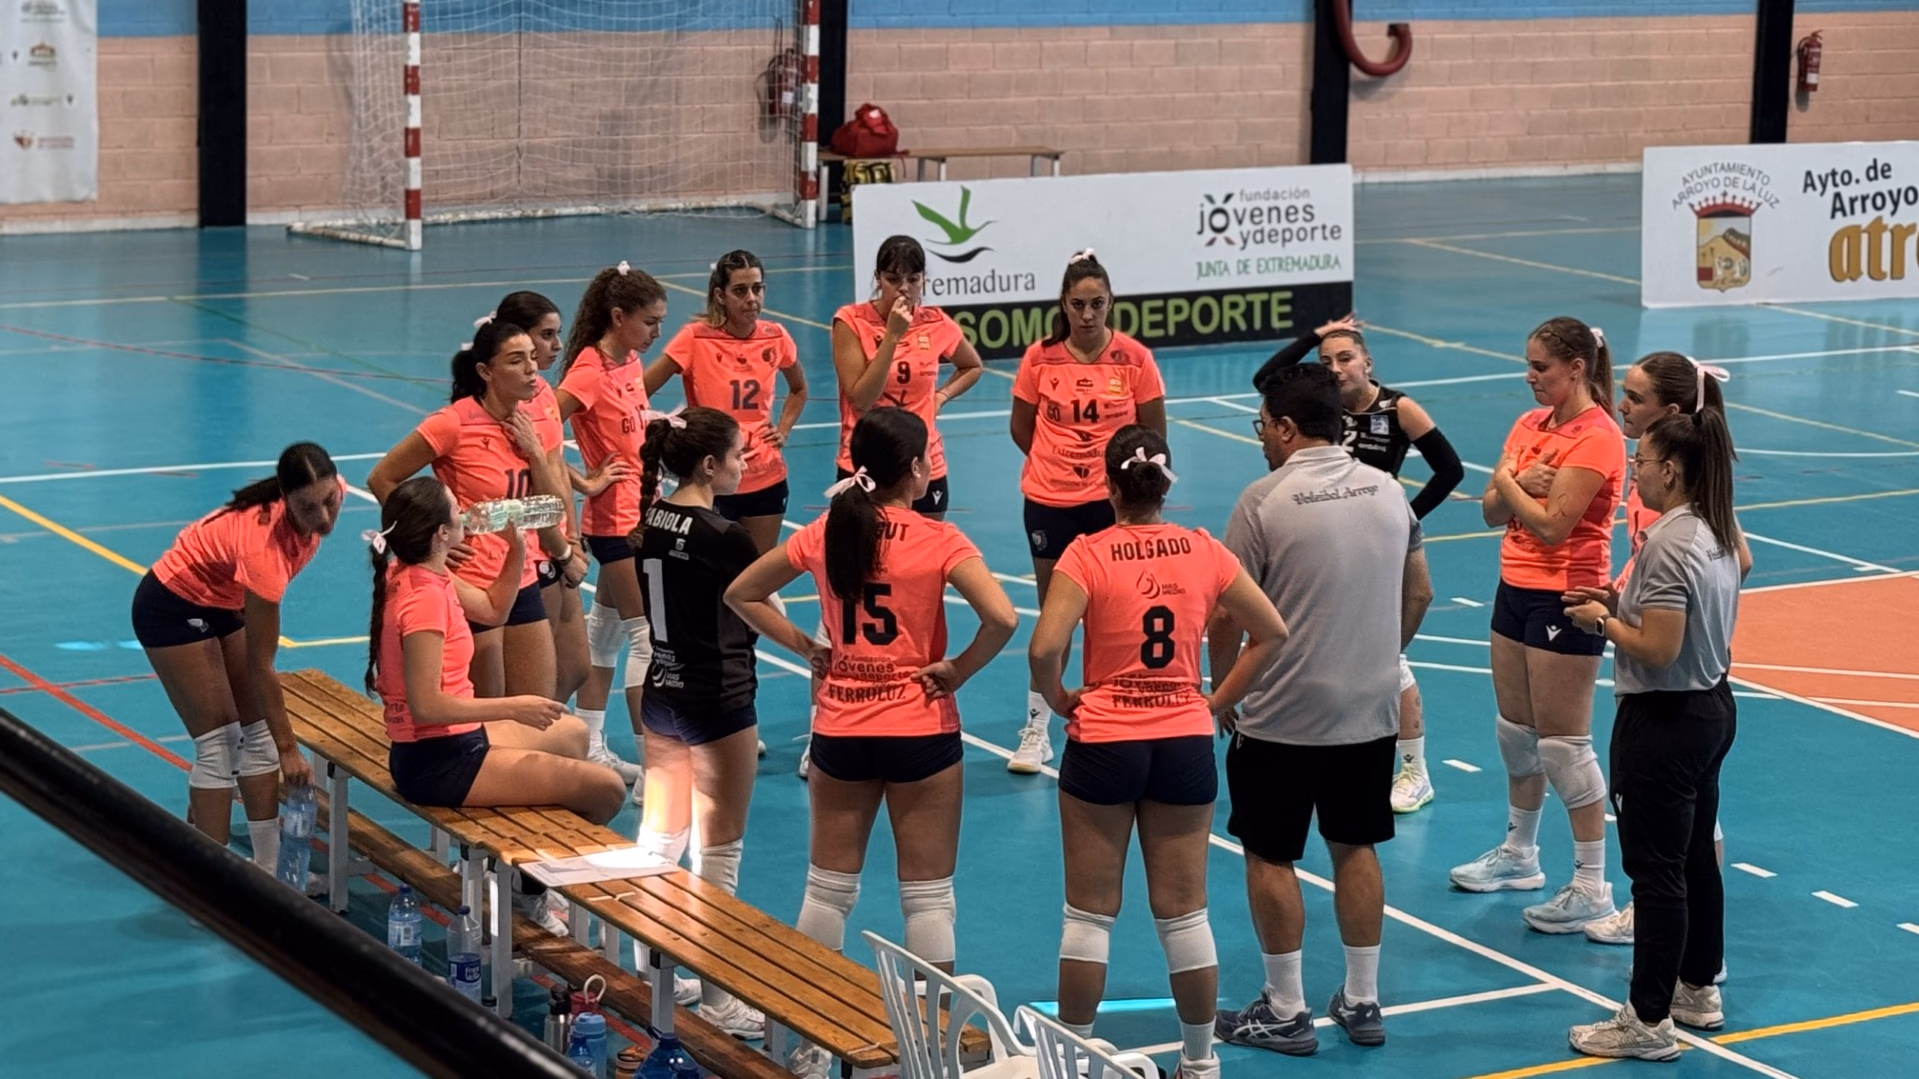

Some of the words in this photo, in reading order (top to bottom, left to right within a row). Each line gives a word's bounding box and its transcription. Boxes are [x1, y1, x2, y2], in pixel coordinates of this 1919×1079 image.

[1682, 162, 1770, 186] AYUNTAMIENTO
[1802, 168, 1860, 197] Ayto.
[1865, 158, 1892, 182] de
[1239, 187, 1310, 202] fundación
[1672, 177, 1720, 210] ARROYO
[1723, 176, 1740, 188] DE
[1742, 179, 1756, 194] LA
[1758, 187, 1780, 209] LUZ
[1830, 185, 1919, 219] Arroyo
[1829, 215, 1919, 283] atr
[922, 269, 1036, 296] remadura
[1196, 260, 1230, 280] JUNTA
[1236, 258, 1251, 276] DE
[1256, 254, 1342, 275] EXTREMADURA
[1114, 291, 1293, 338] DEPORTE
[896, 361, 911, 384] 9
[729, 379, 760, 410] 12
[621, 416, 636, 434] GO
[1071, 398, 1100, 423] 14
[505, 468, 531, 499] 10
[1110, 537, 1191, 561] HOLGADO
[642, 558, 668, 643] 1
[842, 582, 899, 645] 15
[1140, 605, 1175, 669] 8
